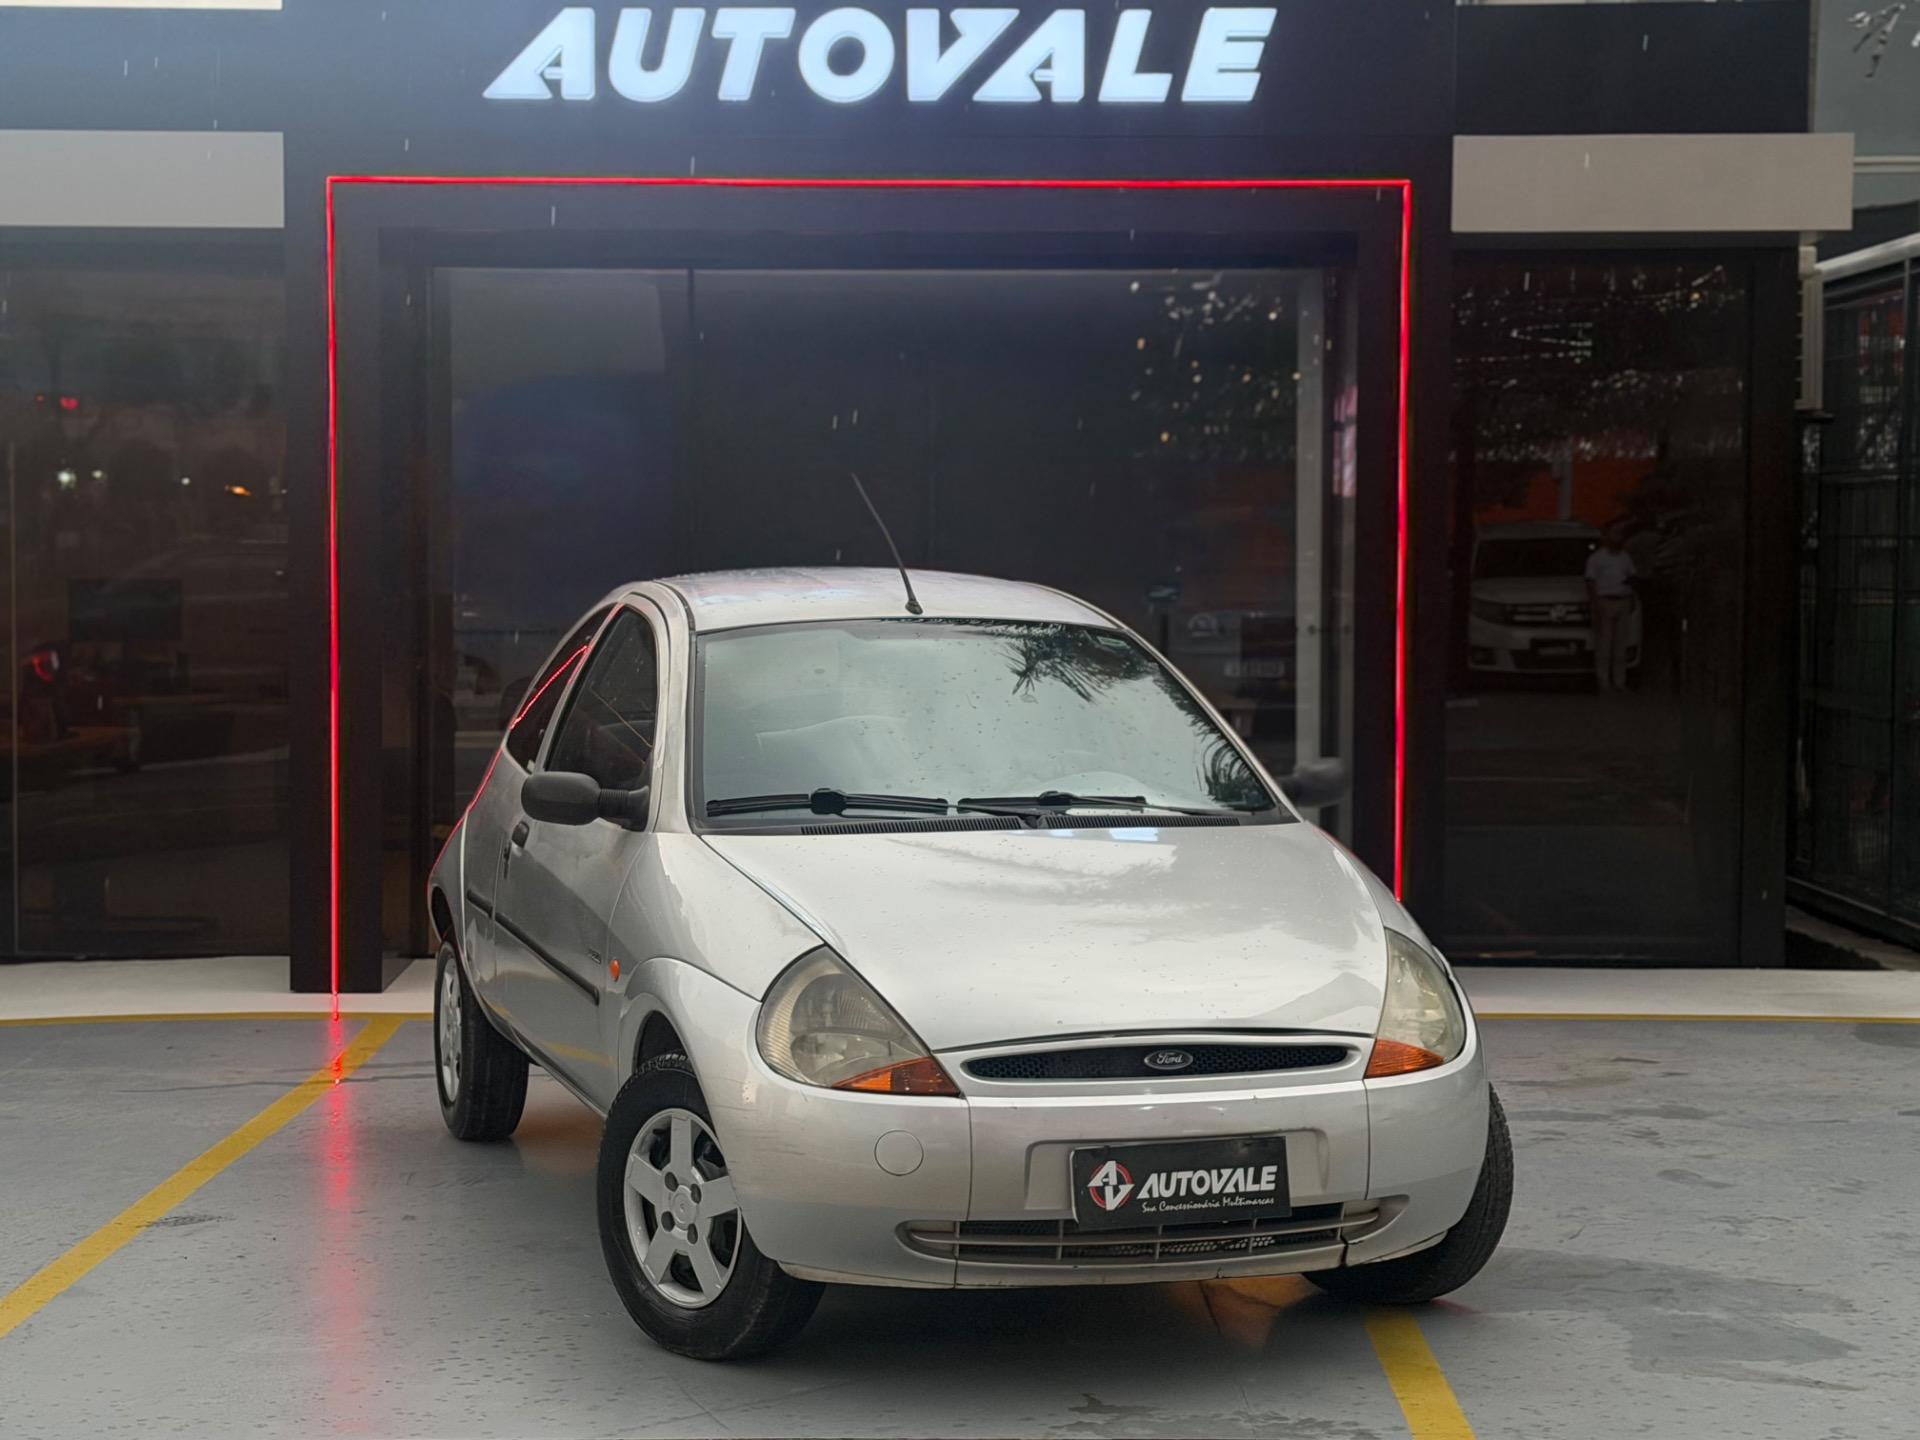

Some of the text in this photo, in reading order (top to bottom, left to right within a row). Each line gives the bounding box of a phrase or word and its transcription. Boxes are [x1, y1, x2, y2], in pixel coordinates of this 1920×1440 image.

[482, 7, 1277, 104] AUTOVALE
[1156, 1052, 1184, 1065] Ford
[1136, 1165, 1278, 1200] AUTOVALE
[1142, 1201, 1157, 1214] Sua
[1222, 1196, 1275, 1207] Multimarcas
